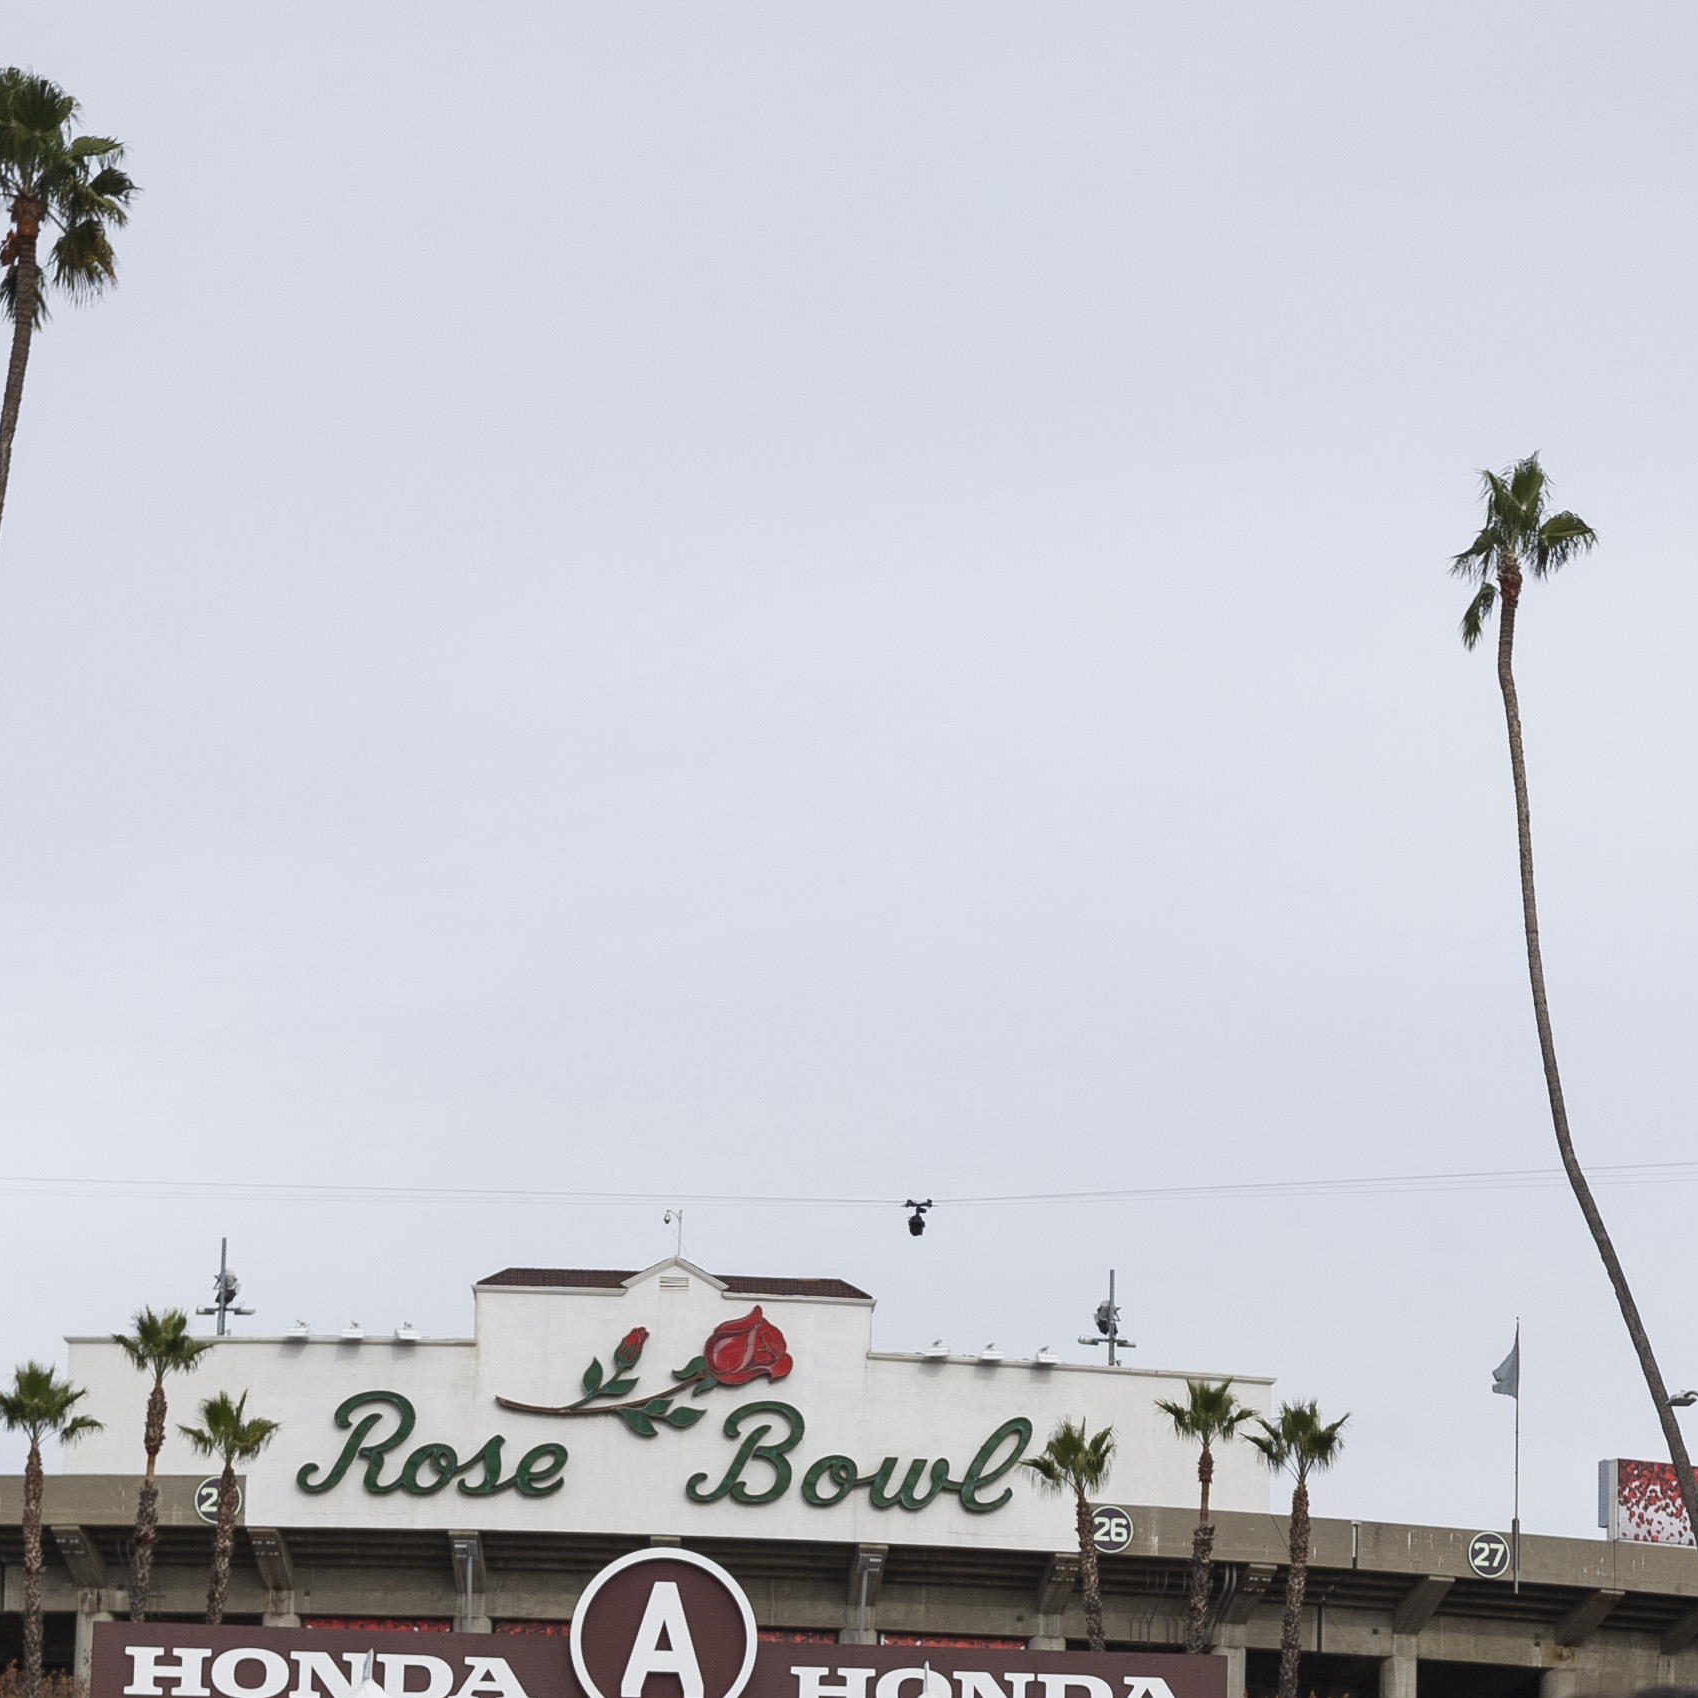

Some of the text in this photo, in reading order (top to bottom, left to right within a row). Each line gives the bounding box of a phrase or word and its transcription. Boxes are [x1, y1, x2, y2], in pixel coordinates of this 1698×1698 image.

[296, 1390, 1033, 1513] Rose Bowl
[200, 1487, 224, 1512] 2
[1093, 1516, 1128, 1542] 26
[1473, 1541, 1505, 1567] 27
